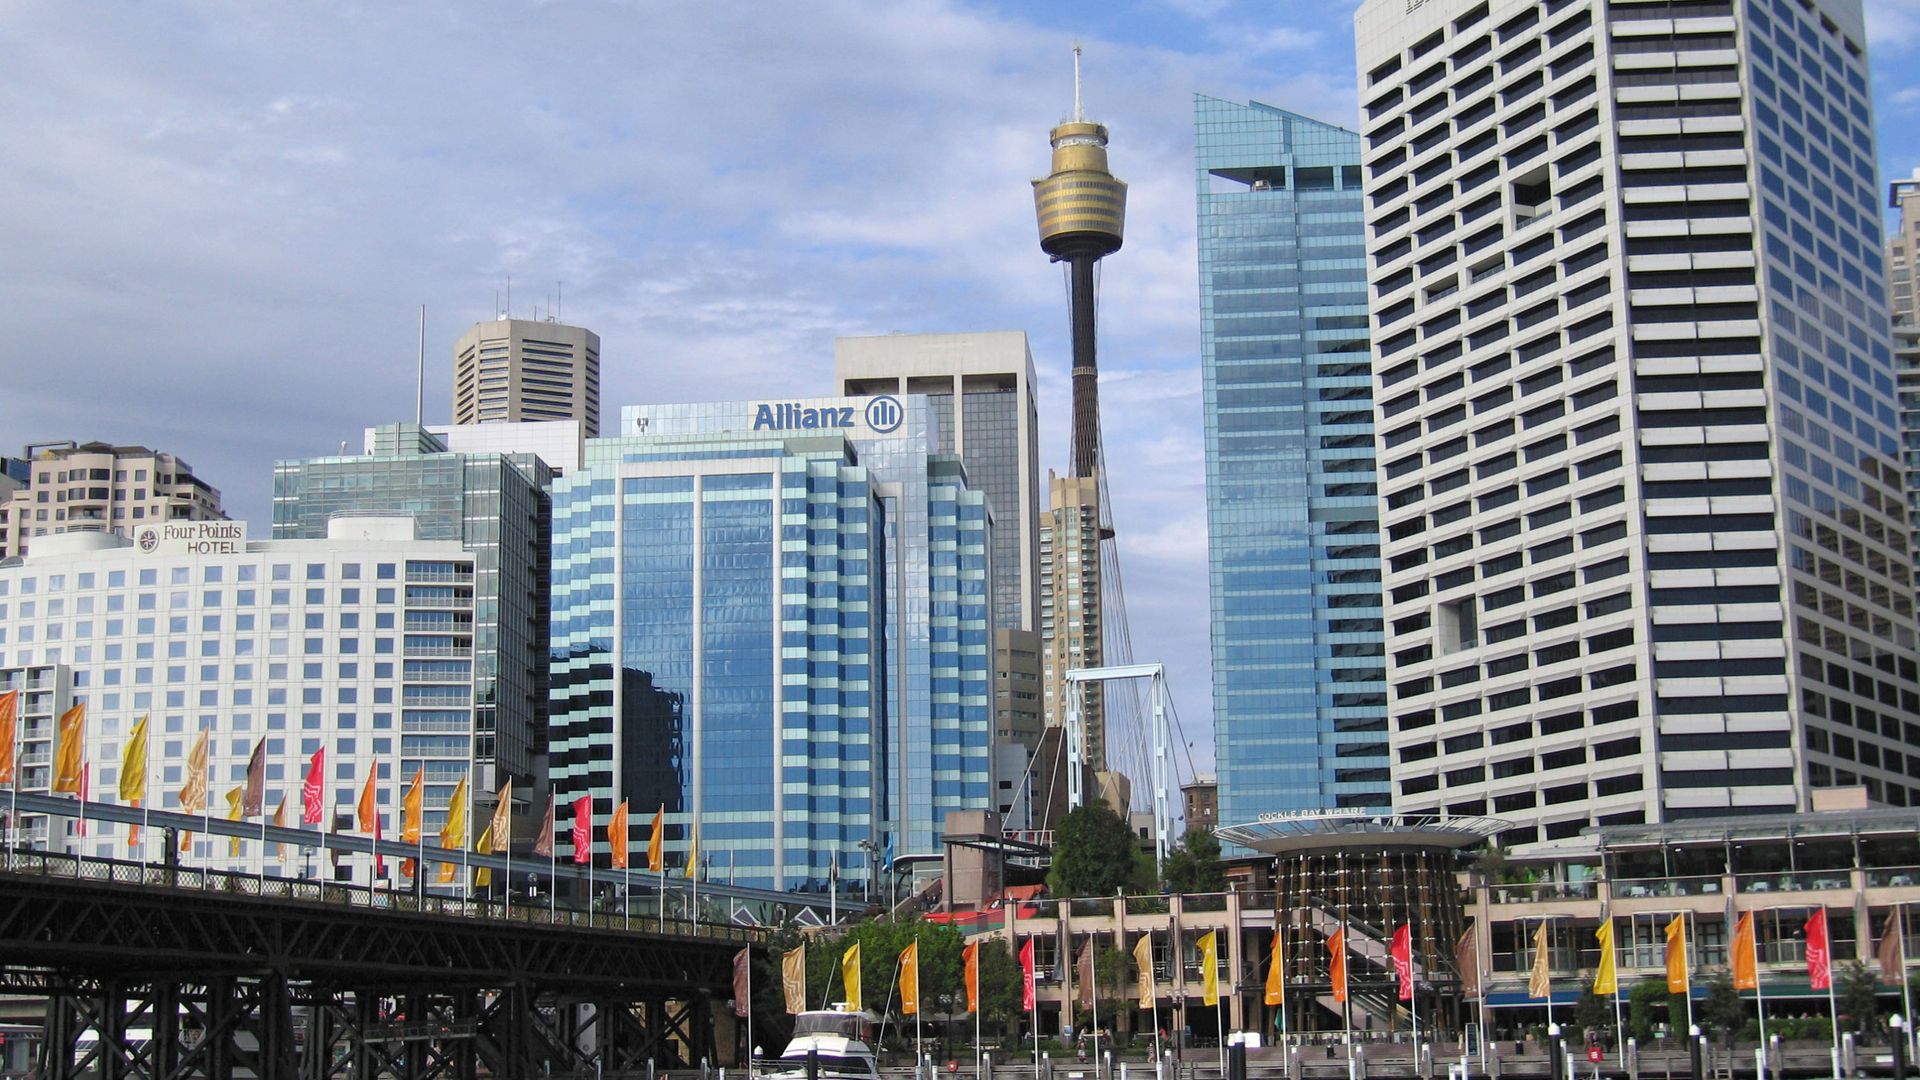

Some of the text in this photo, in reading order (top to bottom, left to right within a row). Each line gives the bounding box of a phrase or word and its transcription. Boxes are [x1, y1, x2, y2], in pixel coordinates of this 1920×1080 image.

[753, 403, 855, 431] Allianz
[164, 523, 242, 540] Four Points
[187, 541, 239, 554] HOTEL
[1258, 810, 1297, 821] COCKLE
